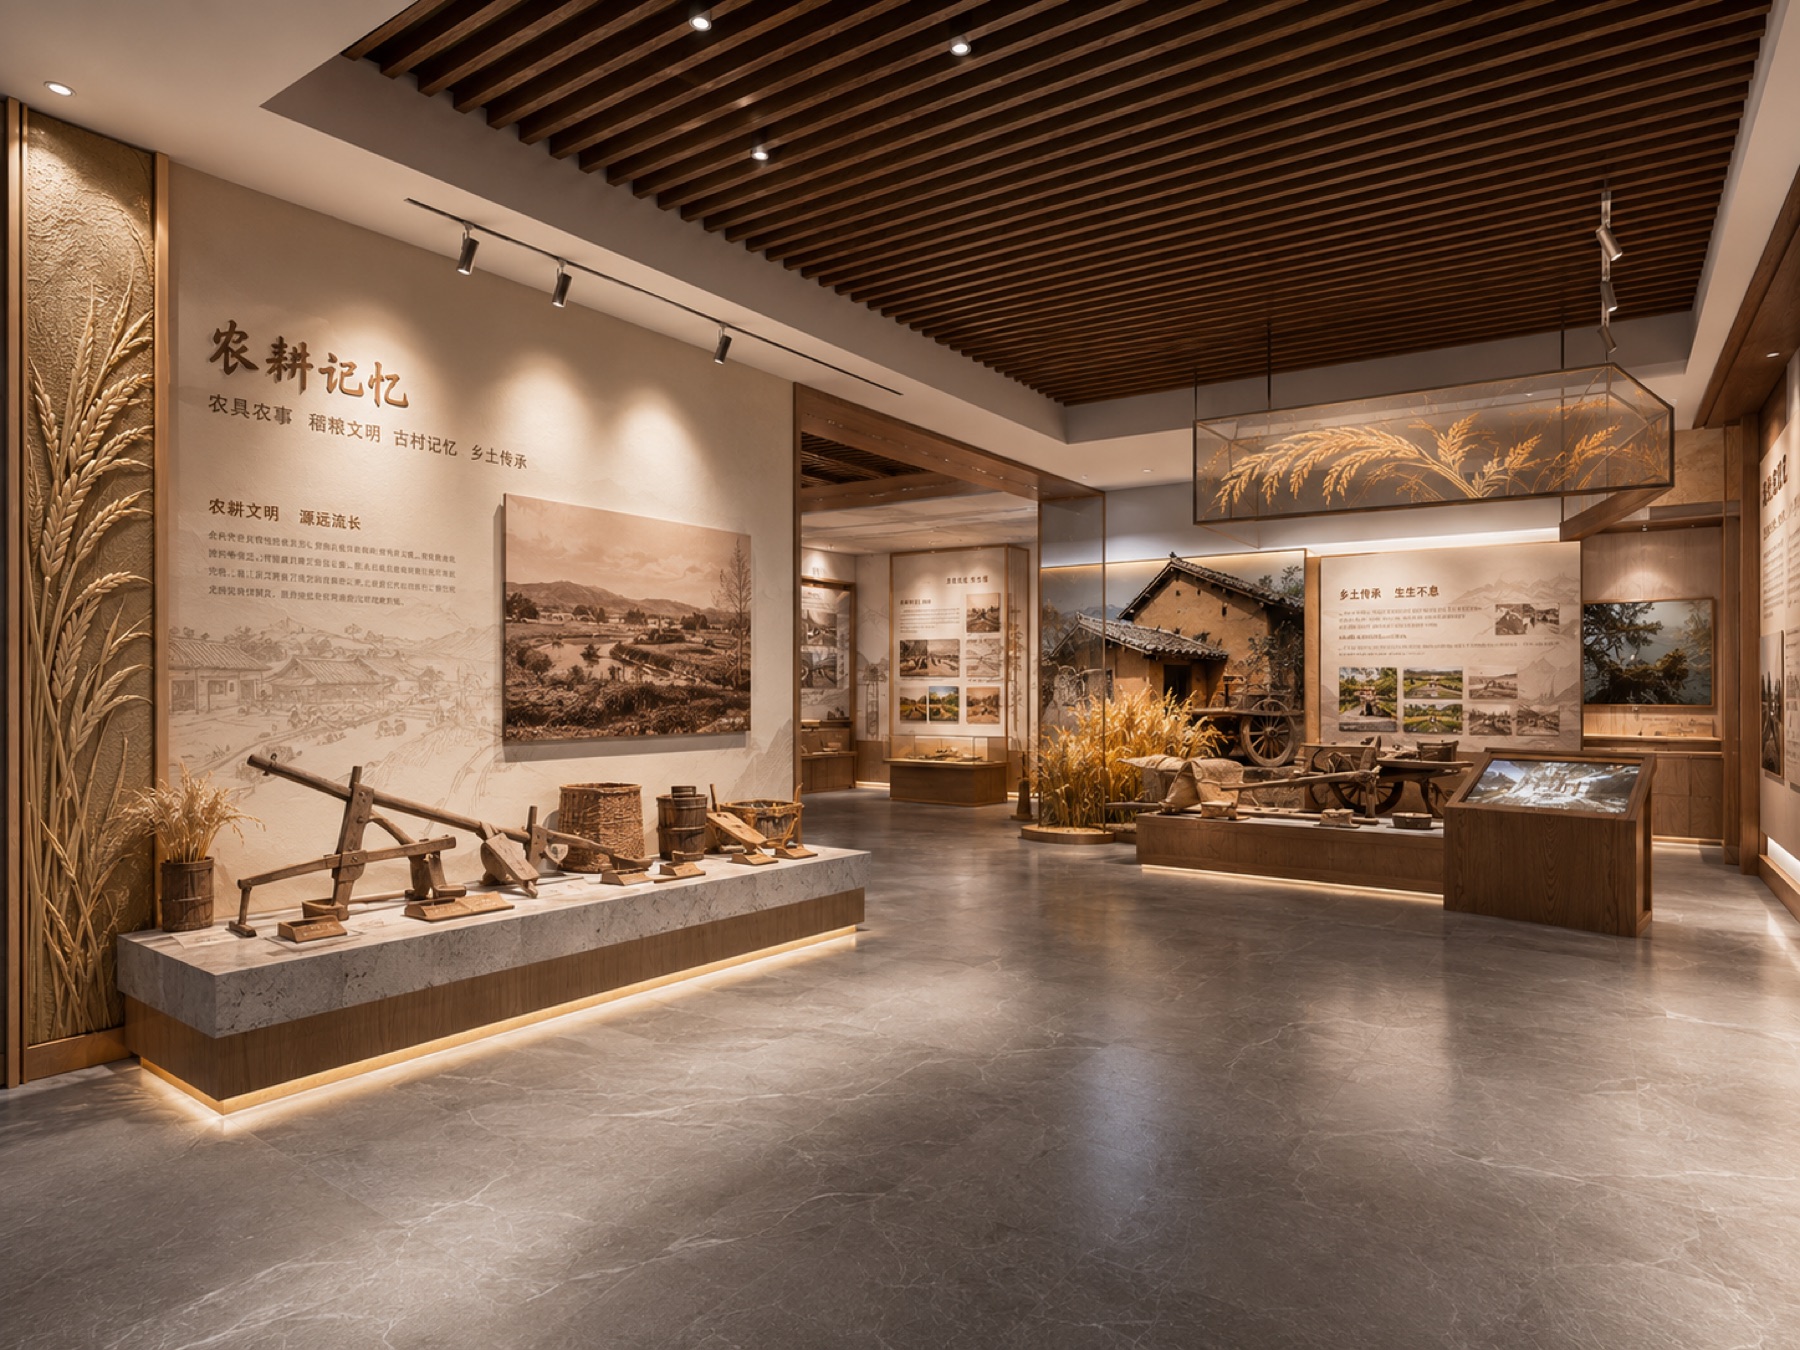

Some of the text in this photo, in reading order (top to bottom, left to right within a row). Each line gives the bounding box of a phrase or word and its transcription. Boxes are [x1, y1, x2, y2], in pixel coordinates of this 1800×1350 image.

[209, 319, 409, 409] 农耕记忆
[208, 394, 293, 426] 农具农事
[394, 429, 458, 457] 古村记忆
[471, 444, 528, 469] 乡土传承
[208, 498, 361, 530] 农耕文明 源远流长
